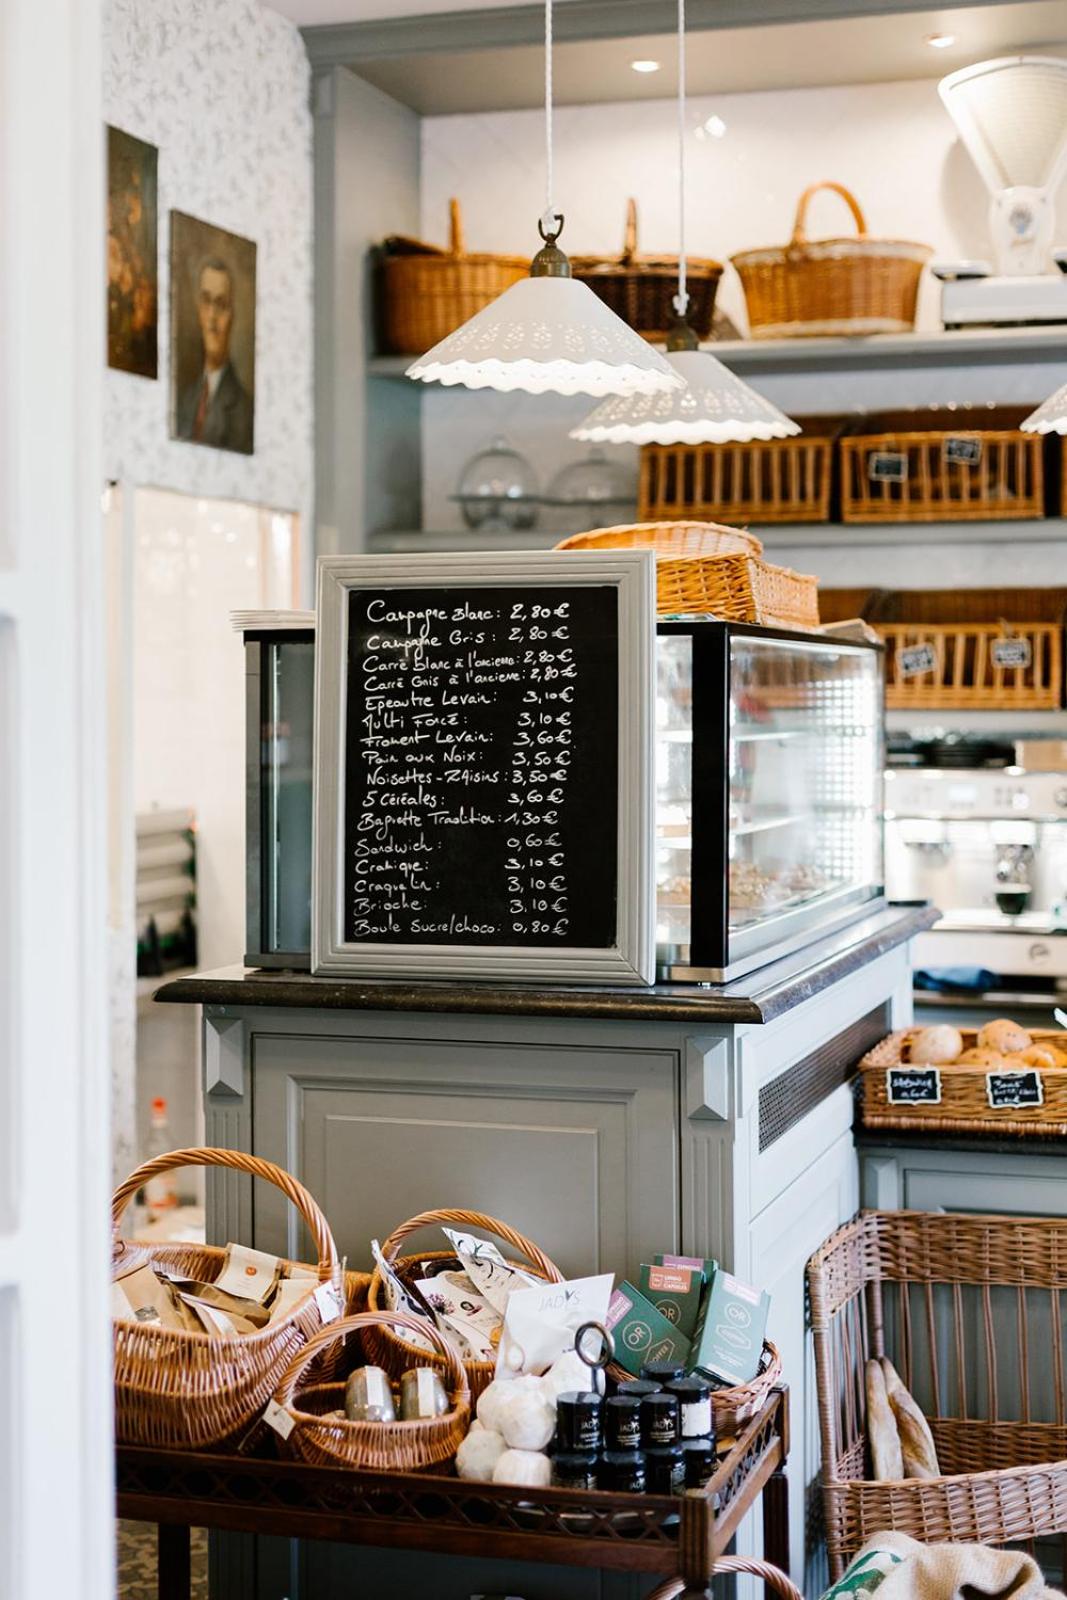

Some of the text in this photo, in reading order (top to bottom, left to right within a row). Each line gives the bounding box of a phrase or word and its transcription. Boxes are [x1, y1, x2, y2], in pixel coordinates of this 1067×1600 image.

[522, 686, 574, 704] 3,10€
[517, 711, 572, 727] 3,10€
[513, 729, 572, 747] 3,60€
[361, 751, 398, 765] Pain
[512, 750, 571, 766] 3,50€
[512, 769, 568, 786] 3,50€
[362, 790, 378, 807] 5
[507, 788, 564, 806] 3,60€
[506, 832, 562, 852] 0,60€
[504, 853, 565, 870] 3,10€
[508, 875, 568, 894] 3,10€
[509, 896, 569, 914] 3,10€
[354, 912, 401, 936] Boule
[512, 918, 569, 936] 0,80€
[628, 1326, 647, 1345] OR
